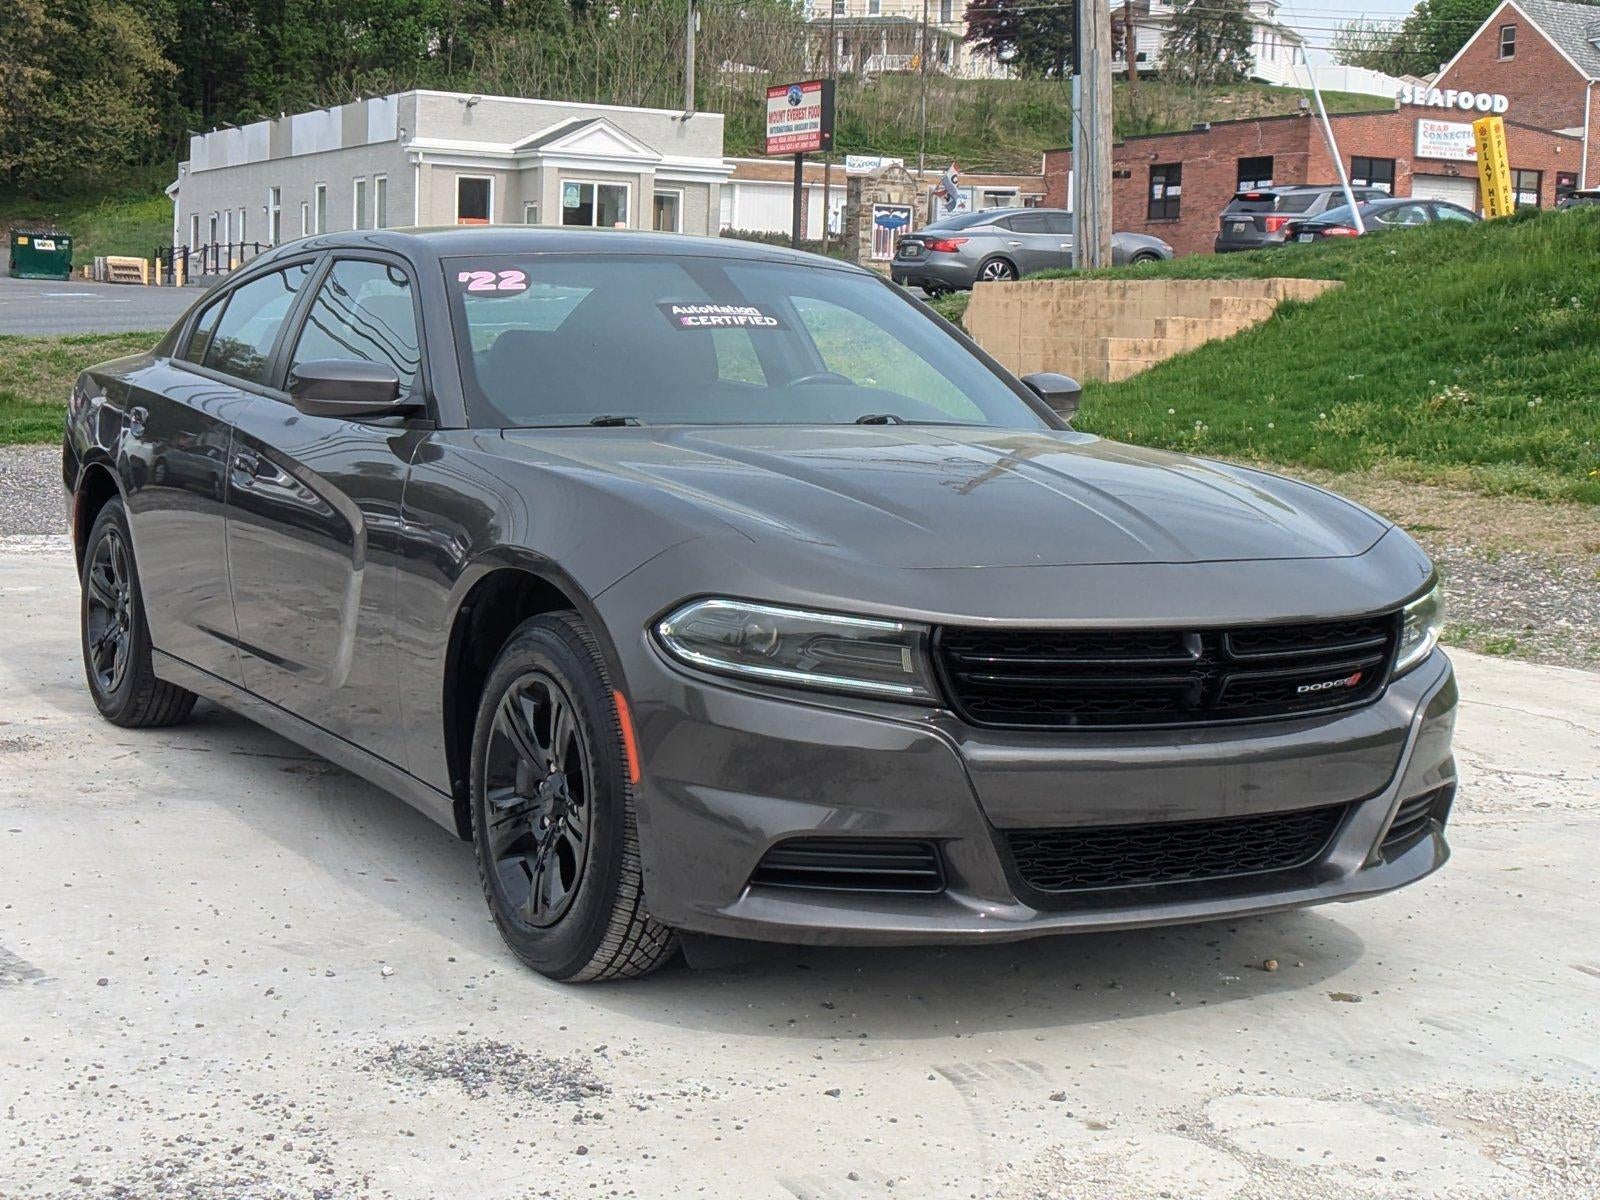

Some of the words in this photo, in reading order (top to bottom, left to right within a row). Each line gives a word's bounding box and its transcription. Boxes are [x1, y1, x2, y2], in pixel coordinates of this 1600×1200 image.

[1401, 84, 1509, 113] SEAFOOD
[768, 109, 787, 124] MOUNT
[786, 106, 808, 122] EVEREST
[672, 304, 760, 316] AutoNation
[687, 316, 778, 326] CERTIFIED
[1297, 677, 1352, 693] DODGE
